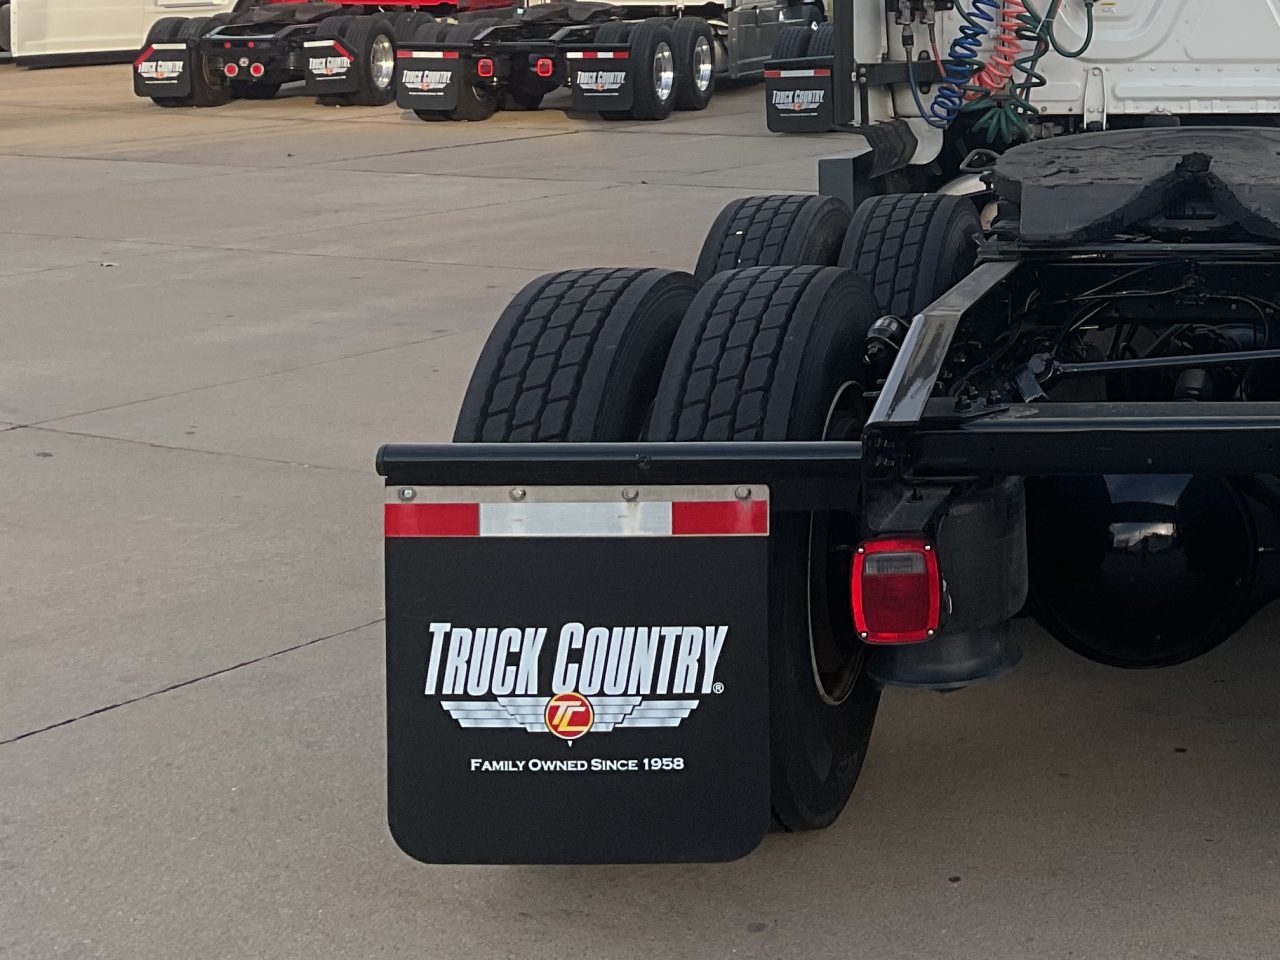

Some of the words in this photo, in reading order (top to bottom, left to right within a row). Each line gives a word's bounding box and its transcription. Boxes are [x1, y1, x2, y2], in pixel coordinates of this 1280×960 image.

[424, 622, 548, 696] TRUCK
[470, 758, 526, 772] FAMILY
[528, 758, 588, 771] OWNED
[590, 758, 638, 771] SINCE
[642, 757, 685, 771] 1958
